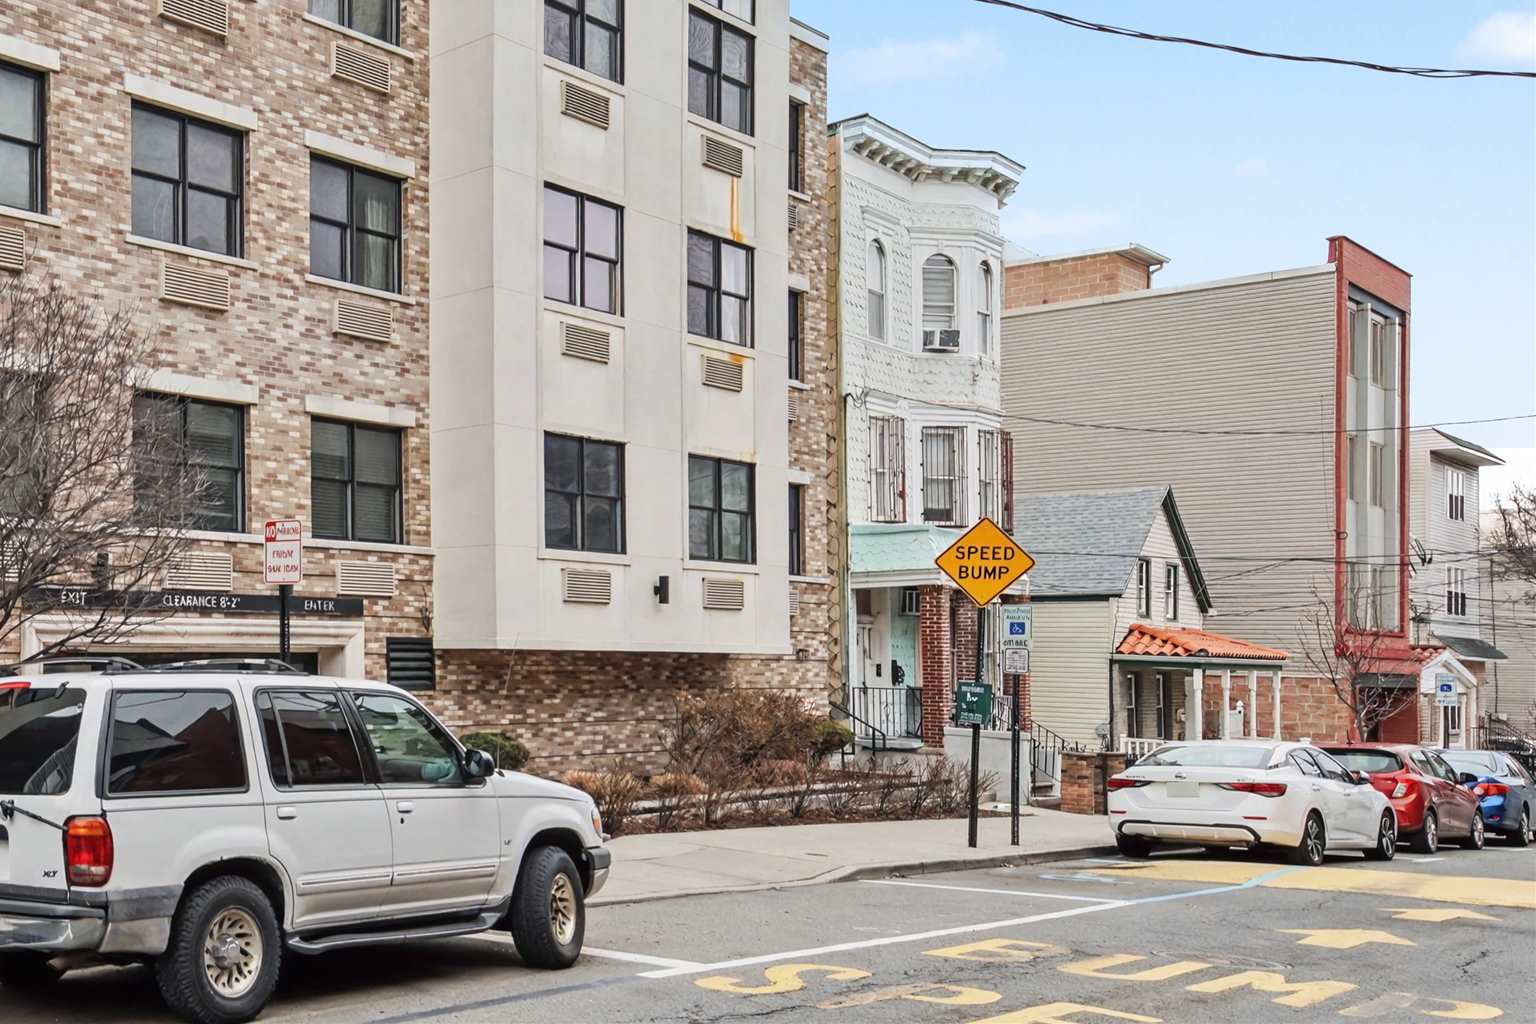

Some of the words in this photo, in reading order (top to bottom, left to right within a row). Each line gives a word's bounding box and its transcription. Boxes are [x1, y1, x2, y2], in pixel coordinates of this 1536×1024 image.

[955, 545, 1015, 561] SPEED
[958, 565, 1009, 580] BUMP
[61, 591, 87, 606] EXIT
[163, 594, 217, 608] CLEARANCE
[304, 599, 335, 612] ENTER
